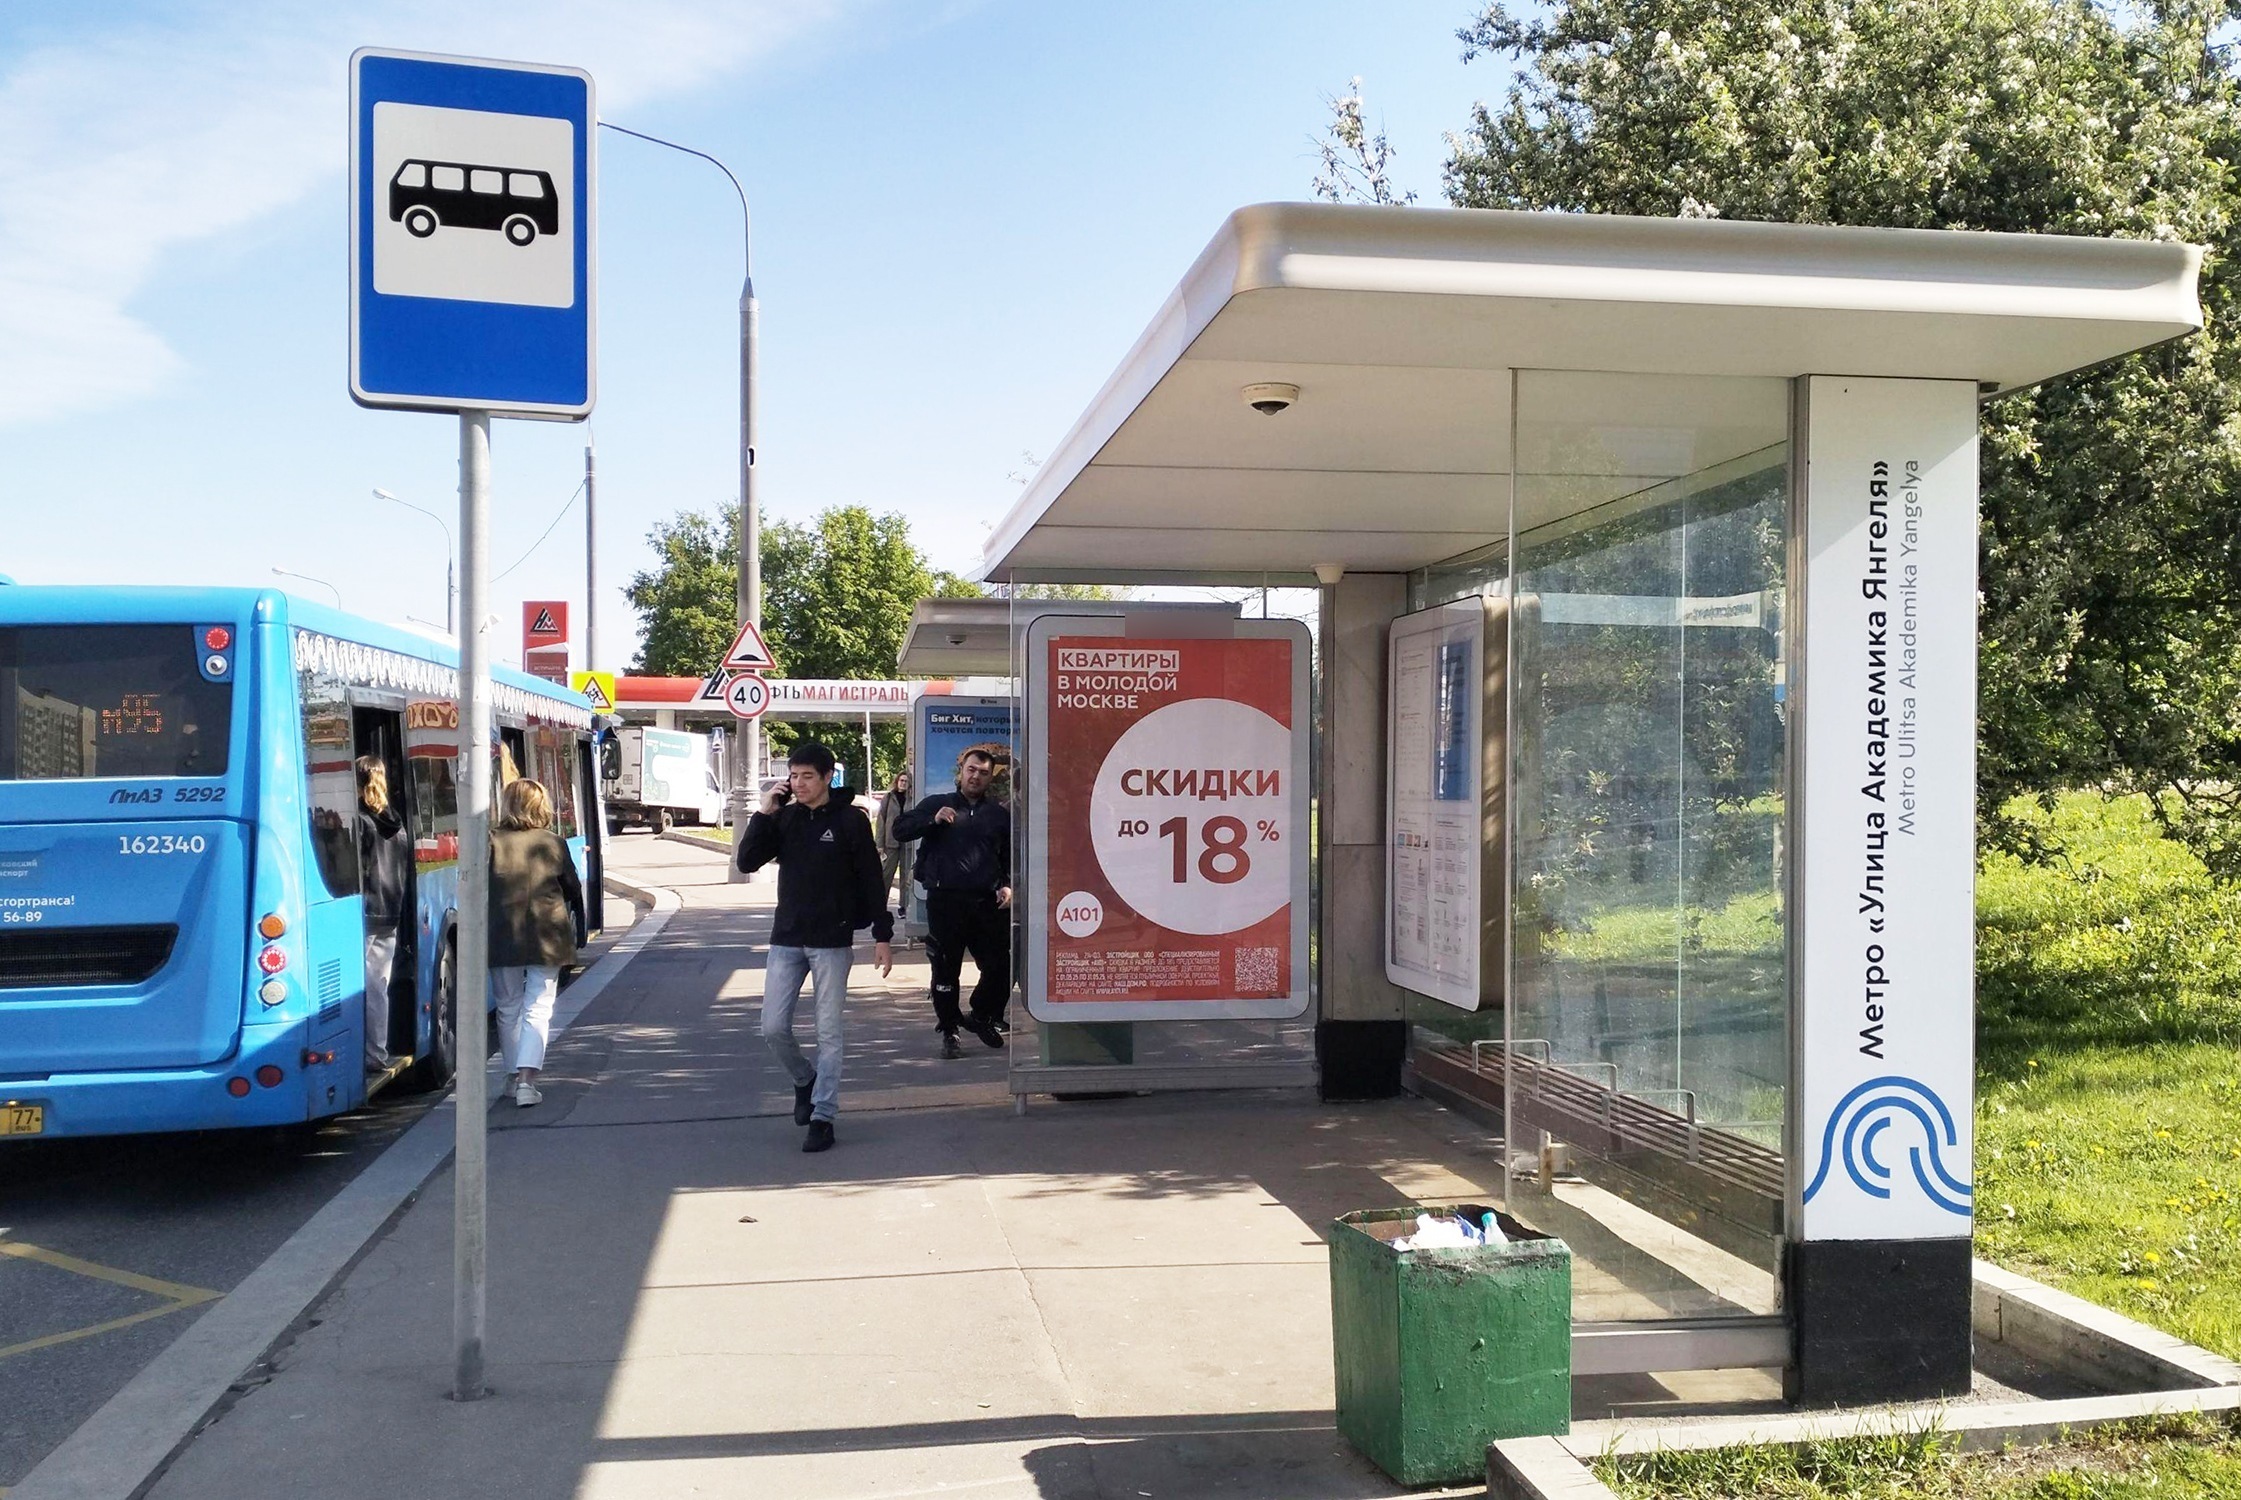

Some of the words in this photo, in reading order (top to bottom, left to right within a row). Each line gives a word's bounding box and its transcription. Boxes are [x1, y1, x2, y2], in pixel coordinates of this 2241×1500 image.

[1900, 460, 1922, 558] Yangelya
[1862, 460, 1889, 601] Янгеля»
[1898, 564, 1918, 689] Akademika
[1061, 652, 1176, 669] КВАРТИРЫ
[1057, 675, 1070, 690] В
[1076, 673, 1177, 693] МОЛОДОЙ
[734, 686, 761, 704] 40
[769, 685, 909, 702] ФТЬМАГИСТРАЛЬ
[1057, 694, 1139, 709] МОСКВЕ
[1861, 611, 1890, 803] Академика
[931, 714, 951, 724] Биг
[1898, 697, 1916, 758] Ulitsa
[174, 787, 226, 803] 5292
[1120, 769, 1280, 801] СКИДКИ
[1898, 766, 1916, 836] Metro
[119, 835, 206, 854] 162340
[1859, 813, 1889, 934] «Улица
[3, 911, 43, 923] 56-89
[1859, 944, 1890, 1060] Метро
[13, 1109, 34, 1125] 77
